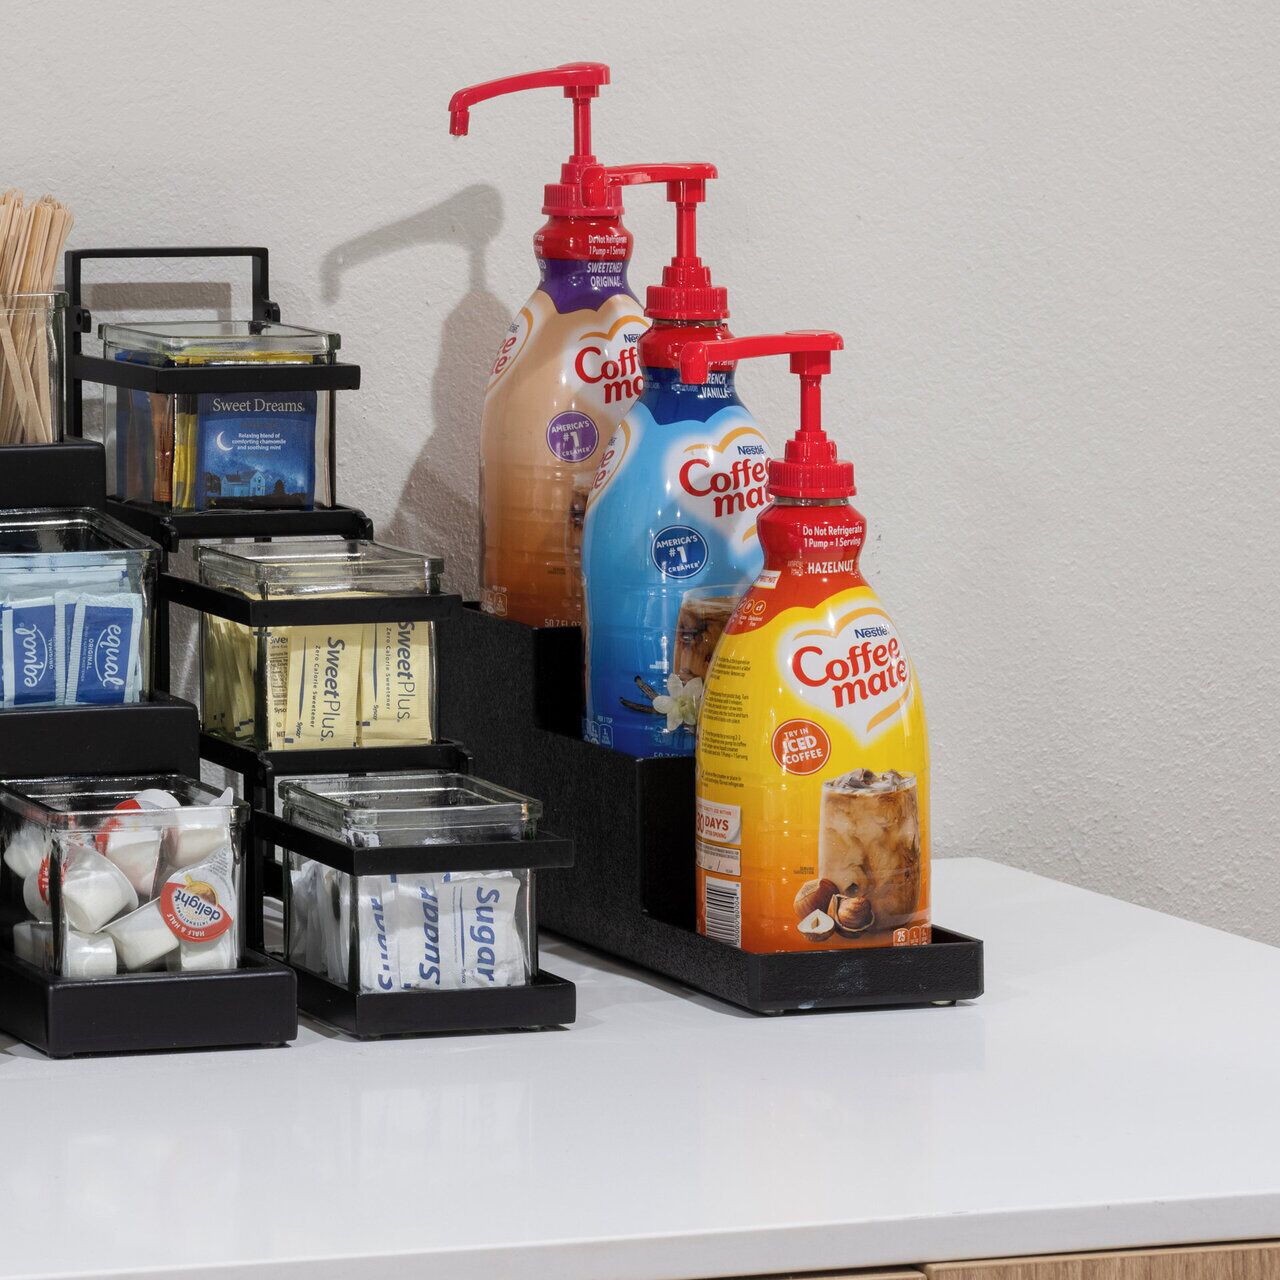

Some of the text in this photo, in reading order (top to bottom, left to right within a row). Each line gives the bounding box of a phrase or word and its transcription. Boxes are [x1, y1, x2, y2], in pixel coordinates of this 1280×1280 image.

[587, 262, 622, 273] SWEETENED
[575, 346, 639, 384] Coff
[707, 373, 726, 385] RENCH
[604, 376, 644, 404] ma
[212, 398, 303, 412] Sweet Dreams
[551, 420, 590, 433] AMERICA'S
[802, 524, 862, 537] Do Not Refrigerate
[656, 534, 698, 549] AMERICA'S
[809, 538, 828, 549] Pump
[839, 536, 861, 547] Serving
[669, 545, 687, 563] #1
[807, 559, 854, 574] HAZELNUT
[14, 624, 44, 688] equal
[86, 638, 94, 670] ORIGINAL
[102, 624, 125, 688] equal
[792, 637, 900, 687] Coffee
[832, 659, 908, 708] mate
[309, 691, 318, 728] Sweetener
[784, 727, 809, 738] TRY IN
[782, 735, 817, 754] ICED
[785, 748, 823, 765] COFFEE
[704, 815, 729, 832] DAYS
[174, 888, 221, 921] delight
[470, 886, 500, 982] Sugar
